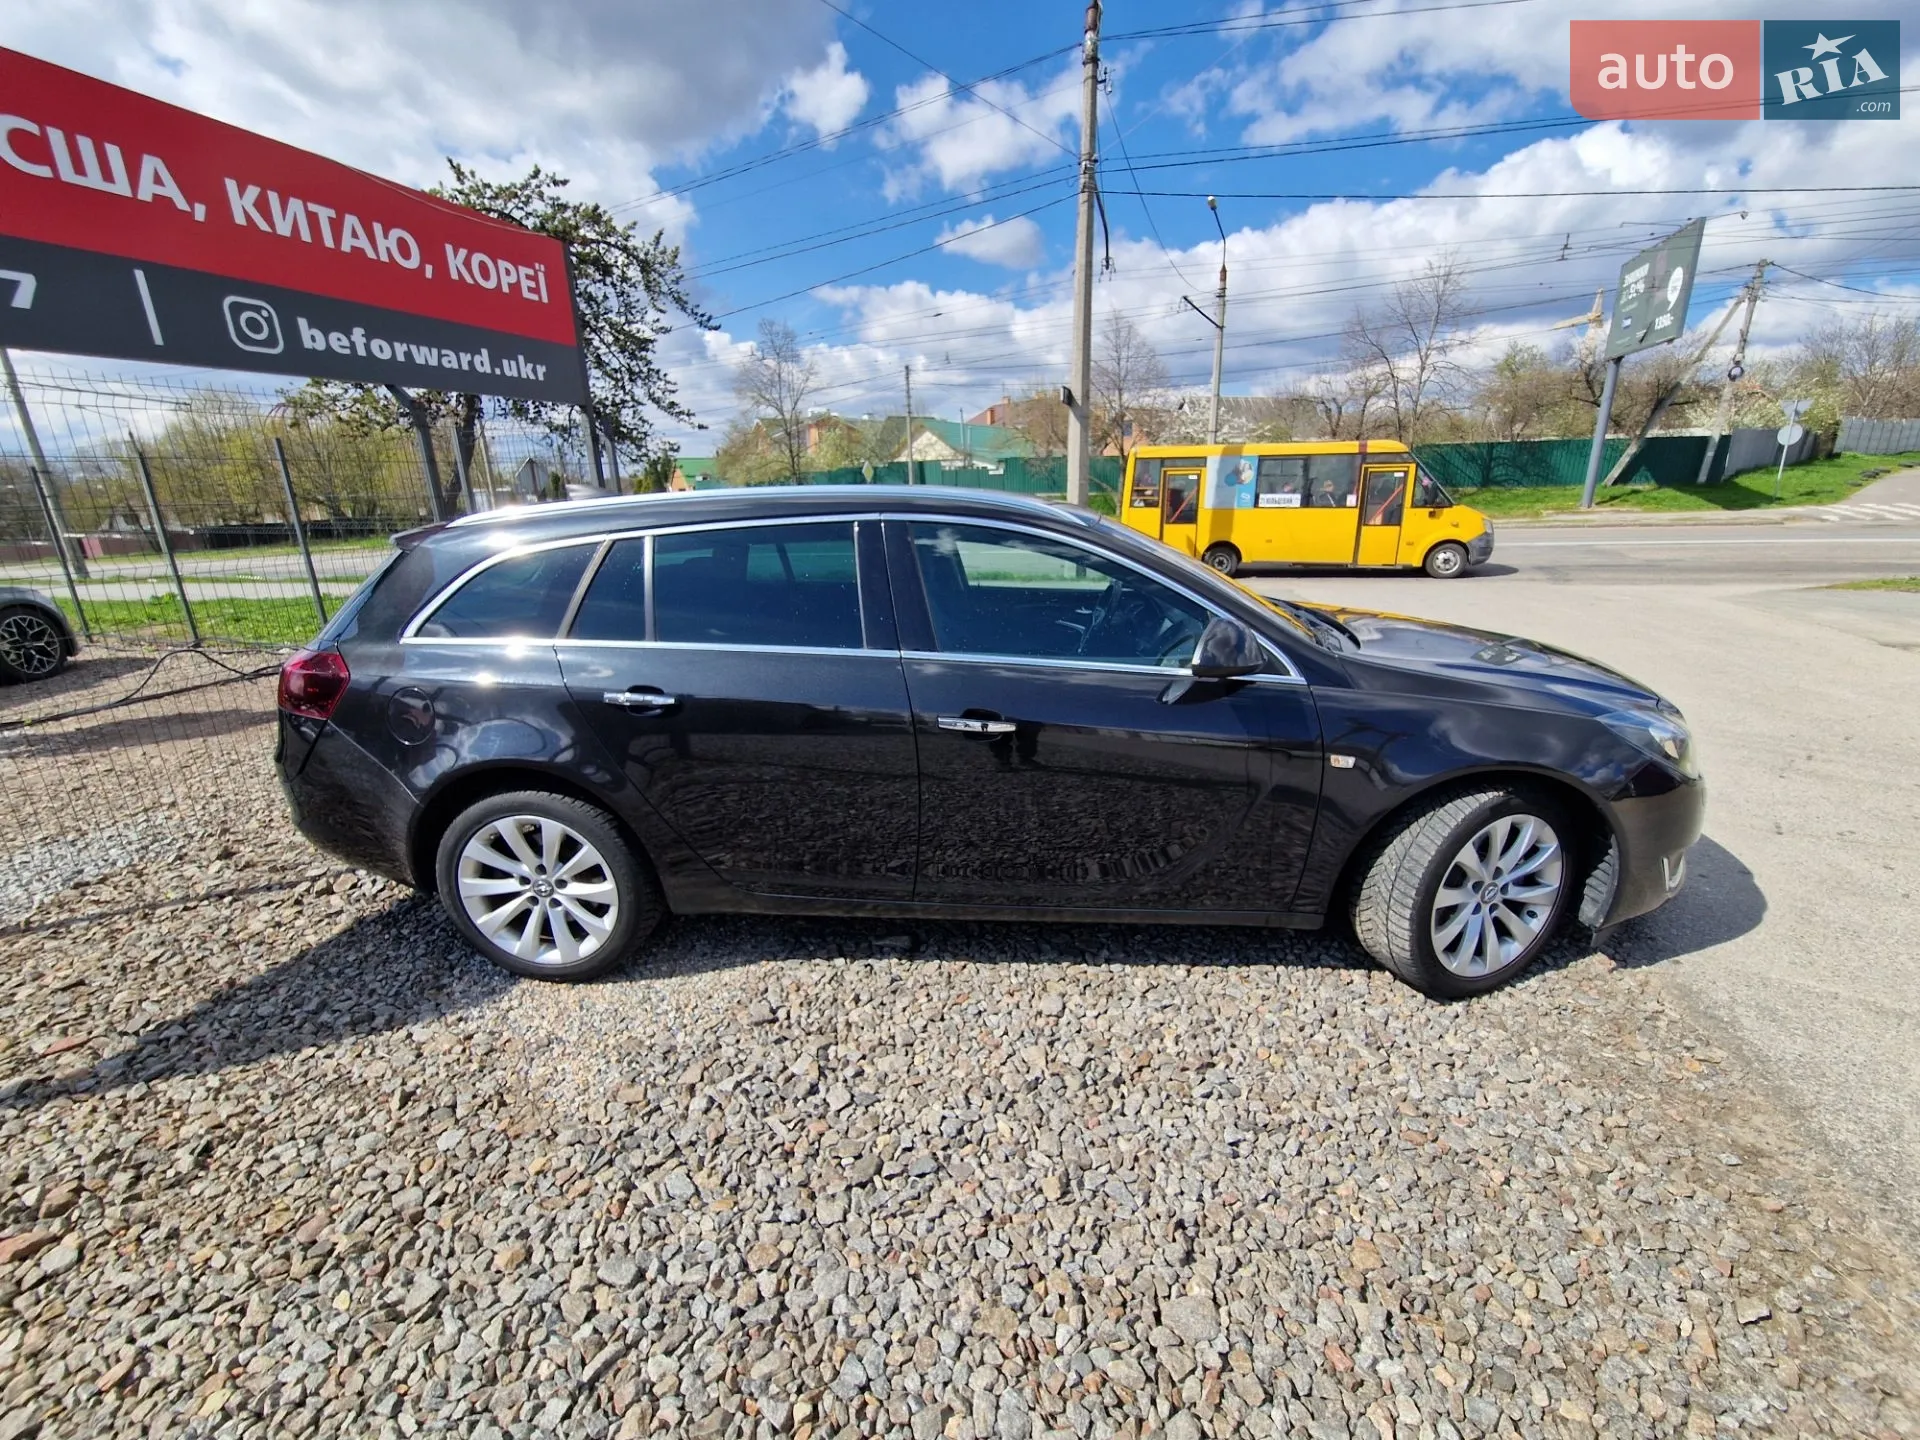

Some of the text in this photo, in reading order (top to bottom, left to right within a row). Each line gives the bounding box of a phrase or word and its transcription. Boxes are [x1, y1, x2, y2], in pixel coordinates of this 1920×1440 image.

[0, 114, 549, 303] США, КИТАЮ, КОРЕЇ
[297, 317, 547, 381] beforward.ukr
